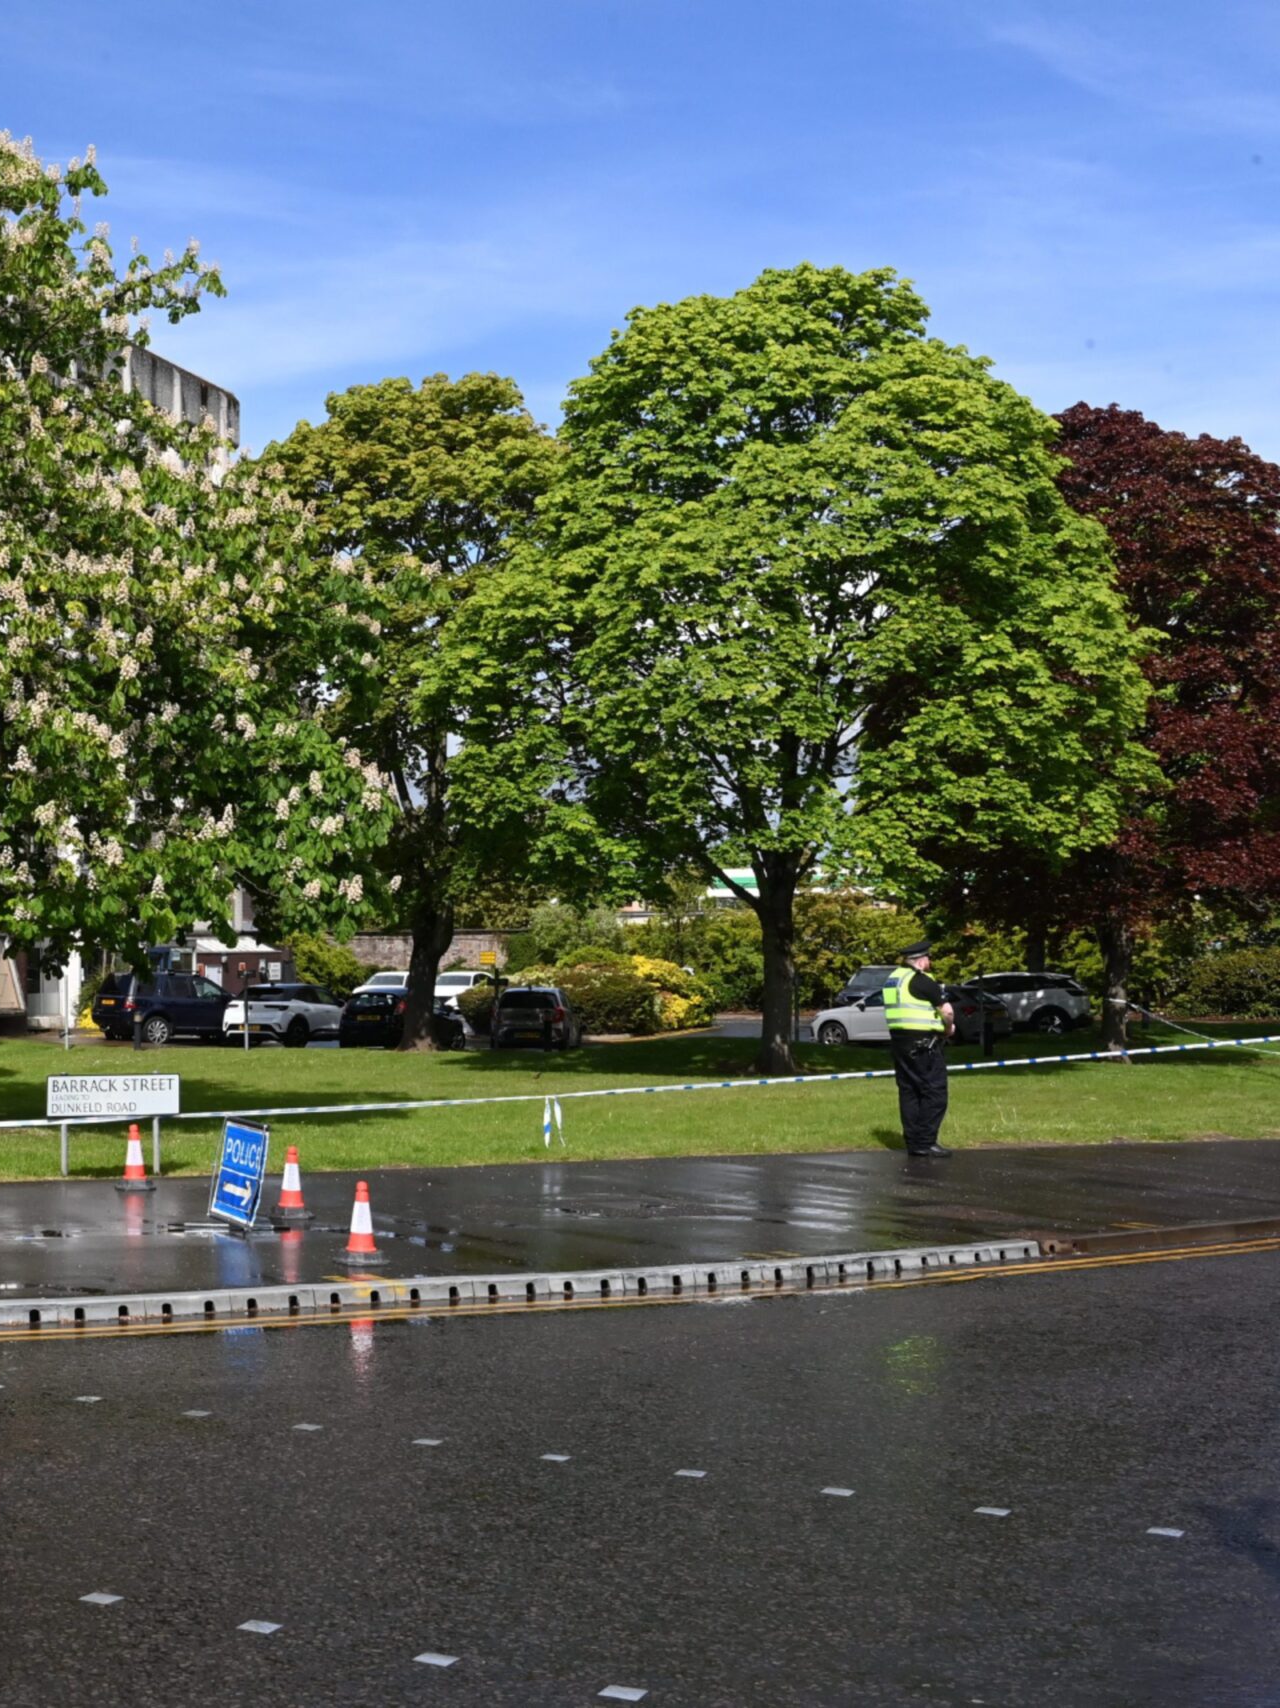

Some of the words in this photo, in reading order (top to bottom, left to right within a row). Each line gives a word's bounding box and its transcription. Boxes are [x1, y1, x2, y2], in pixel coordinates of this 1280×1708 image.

[51, 1078, 118, 1093] BARRACK
[122, 1077, 175, 1092] STREET
[51, 1102, 102, 1113] DUNKELD
[106, 1101, 137, 1112] ROAD
